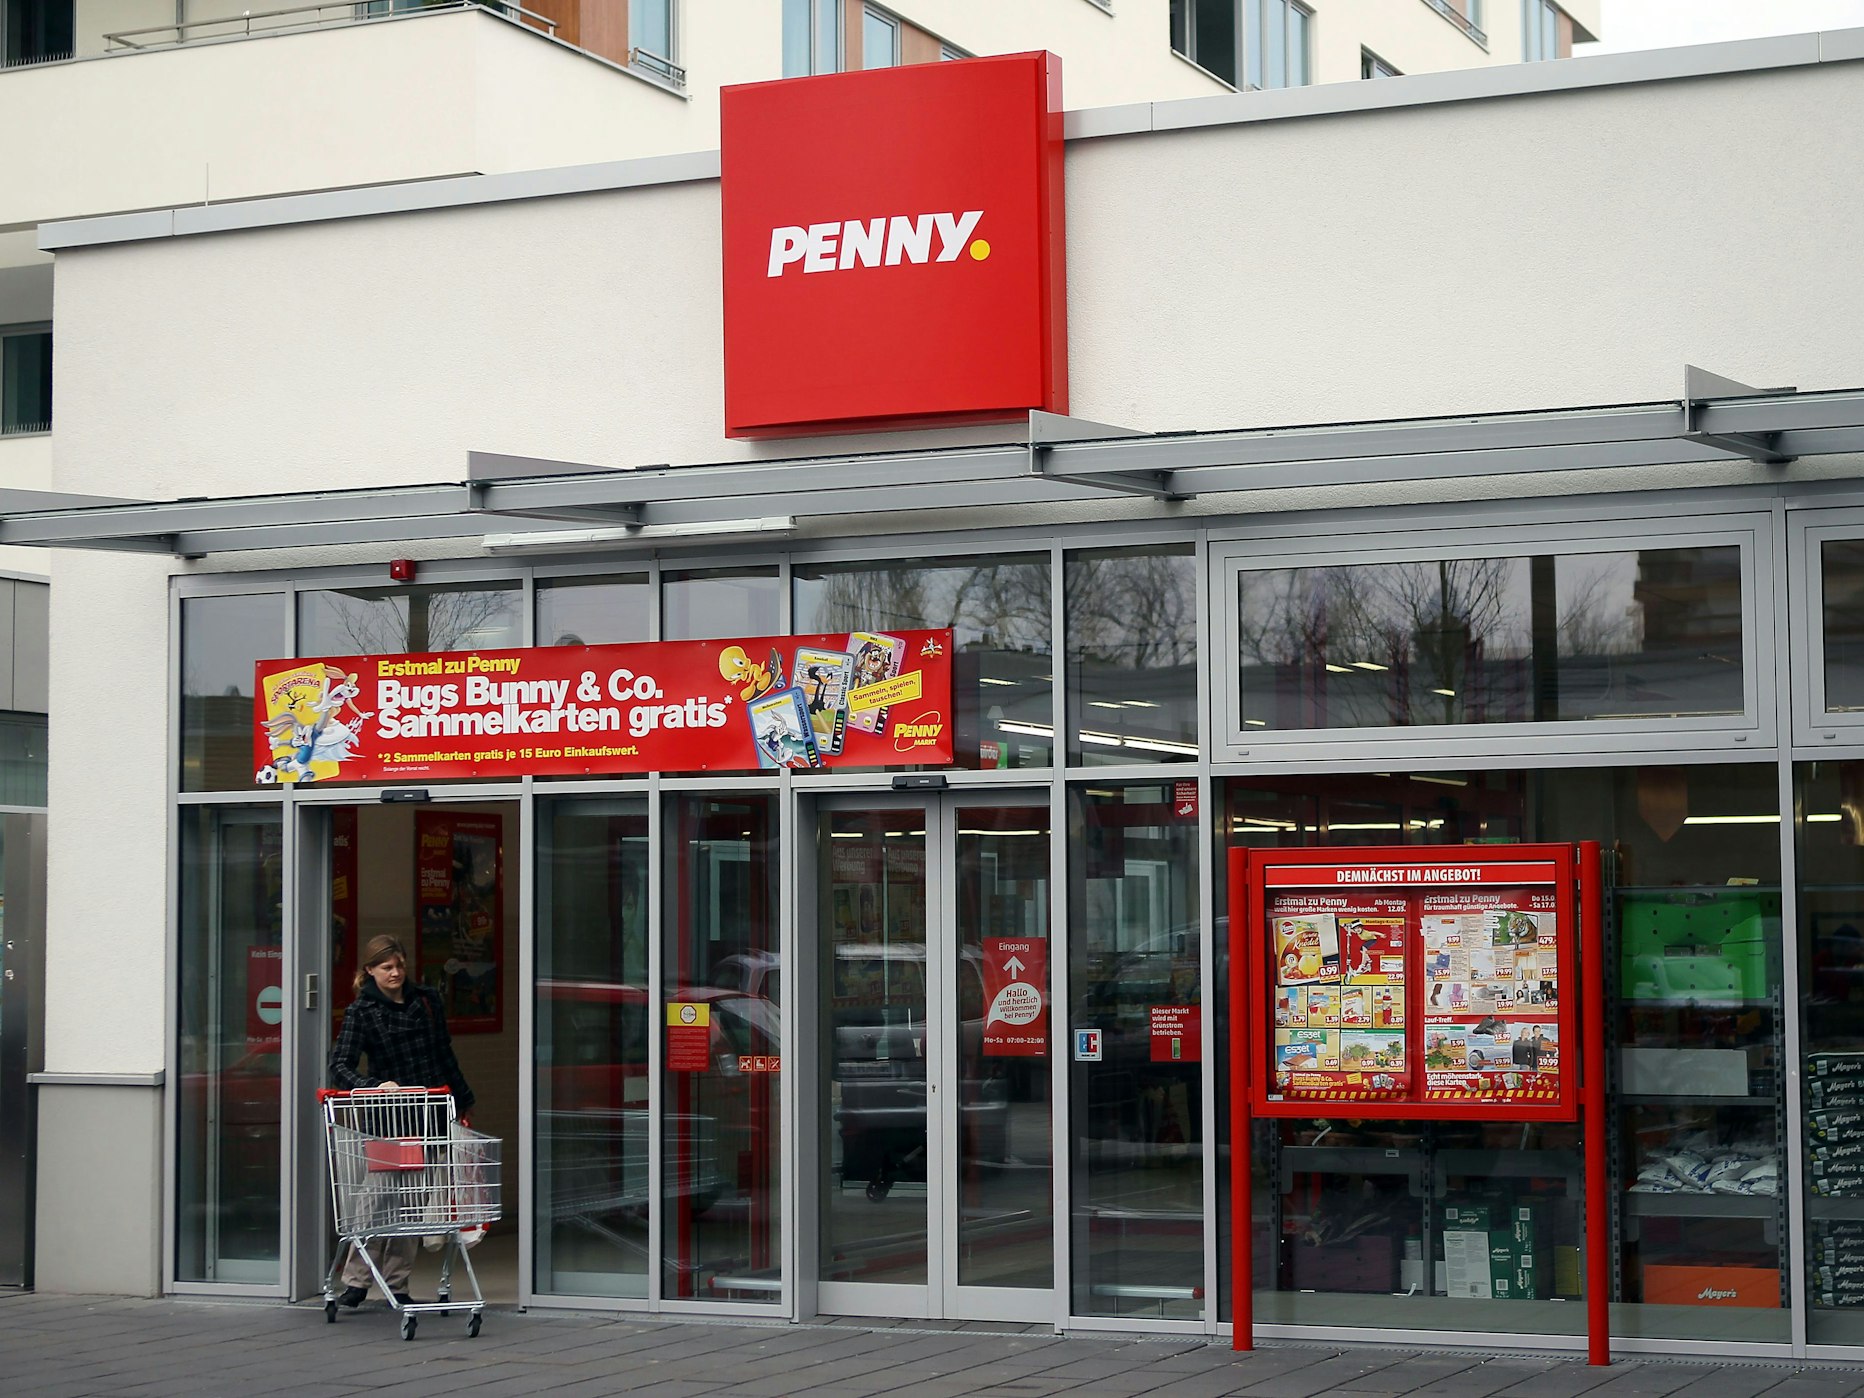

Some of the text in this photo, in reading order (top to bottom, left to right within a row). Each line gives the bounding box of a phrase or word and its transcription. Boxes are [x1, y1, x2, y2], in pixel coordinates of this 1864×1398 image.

[767, 210, 990, 278] PENNY.
[377, 656, 521, 677] Erstmal zu Penny
[890, 661, 899, 678] Sport
[377, 668, 664, 715] Bugs Bunny & Co.
[838, 671, 850, 706] Classic Sport
[853, 679, 916, 701] Sammeln, spielen,
[869, 690, 903, 704] tauschen!
[376, 703, 620, 739] Sammelkarten
[893, 723, 943, 738] PENNY
[913, 738, 937, 746] MARKT
[393, 751, 471, 763] Sammelkarten
[474, 749, 504, 762] gratis
[505, 749, 516, 761] je
[519, 748, 533, 758] 15
[535, 747, 562, 758] Euro
[564, 745, 639, 757] Einkaufswert.
[1336, 868, 1481, 882] DEMNÄCHST IM ANGEBOT!
[1274, 897, 1347, 908] Erstmal zu Penny
[1384, 899, 1406, 907] Montag
[1424, 894, 1501, 904] Erstmal zu Penny
[1463, 903, 1488, 911] günstige
[998, 942, 1030, 953] Eingang
[267, 950, 282, 960] Eing
[1319, 966, 1338, 976] 0.99
[1006, 988, 1028, 998] Hallo
[998, 996, 1038, 1006] und herzlich
[1000, 1004, 1037, 1013] Willkommen
[1004, 1011, 1035, 1020] bei Penny!
[1538, 1057, 1559, 1066] 19.99
[1697, 1287, 1737, 1300] Mayer's
